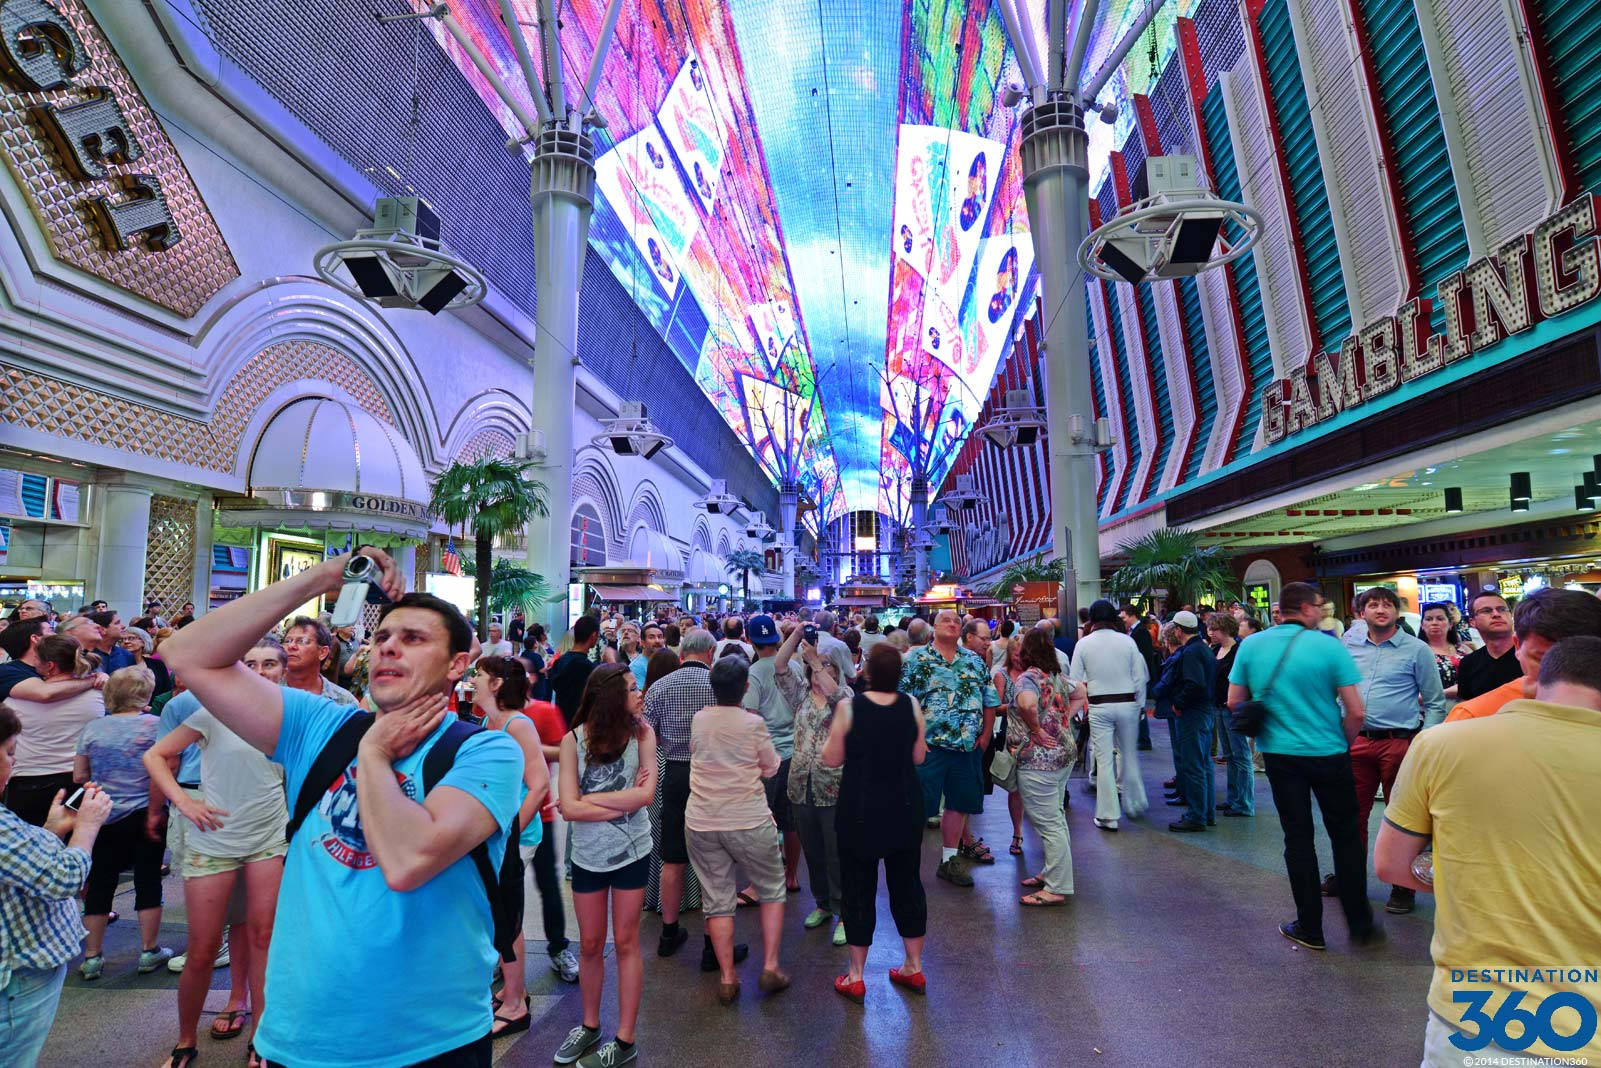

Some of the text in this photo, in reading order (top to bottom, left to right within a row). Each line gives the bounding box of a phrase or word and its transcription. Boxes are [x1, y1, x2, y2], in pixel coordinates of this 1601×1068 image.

[1261, 191, 1601, 447] GAMBLING
[352, 496, 416, 517] GOLDEN
[327, 841, 377, 866] HILFIGE
